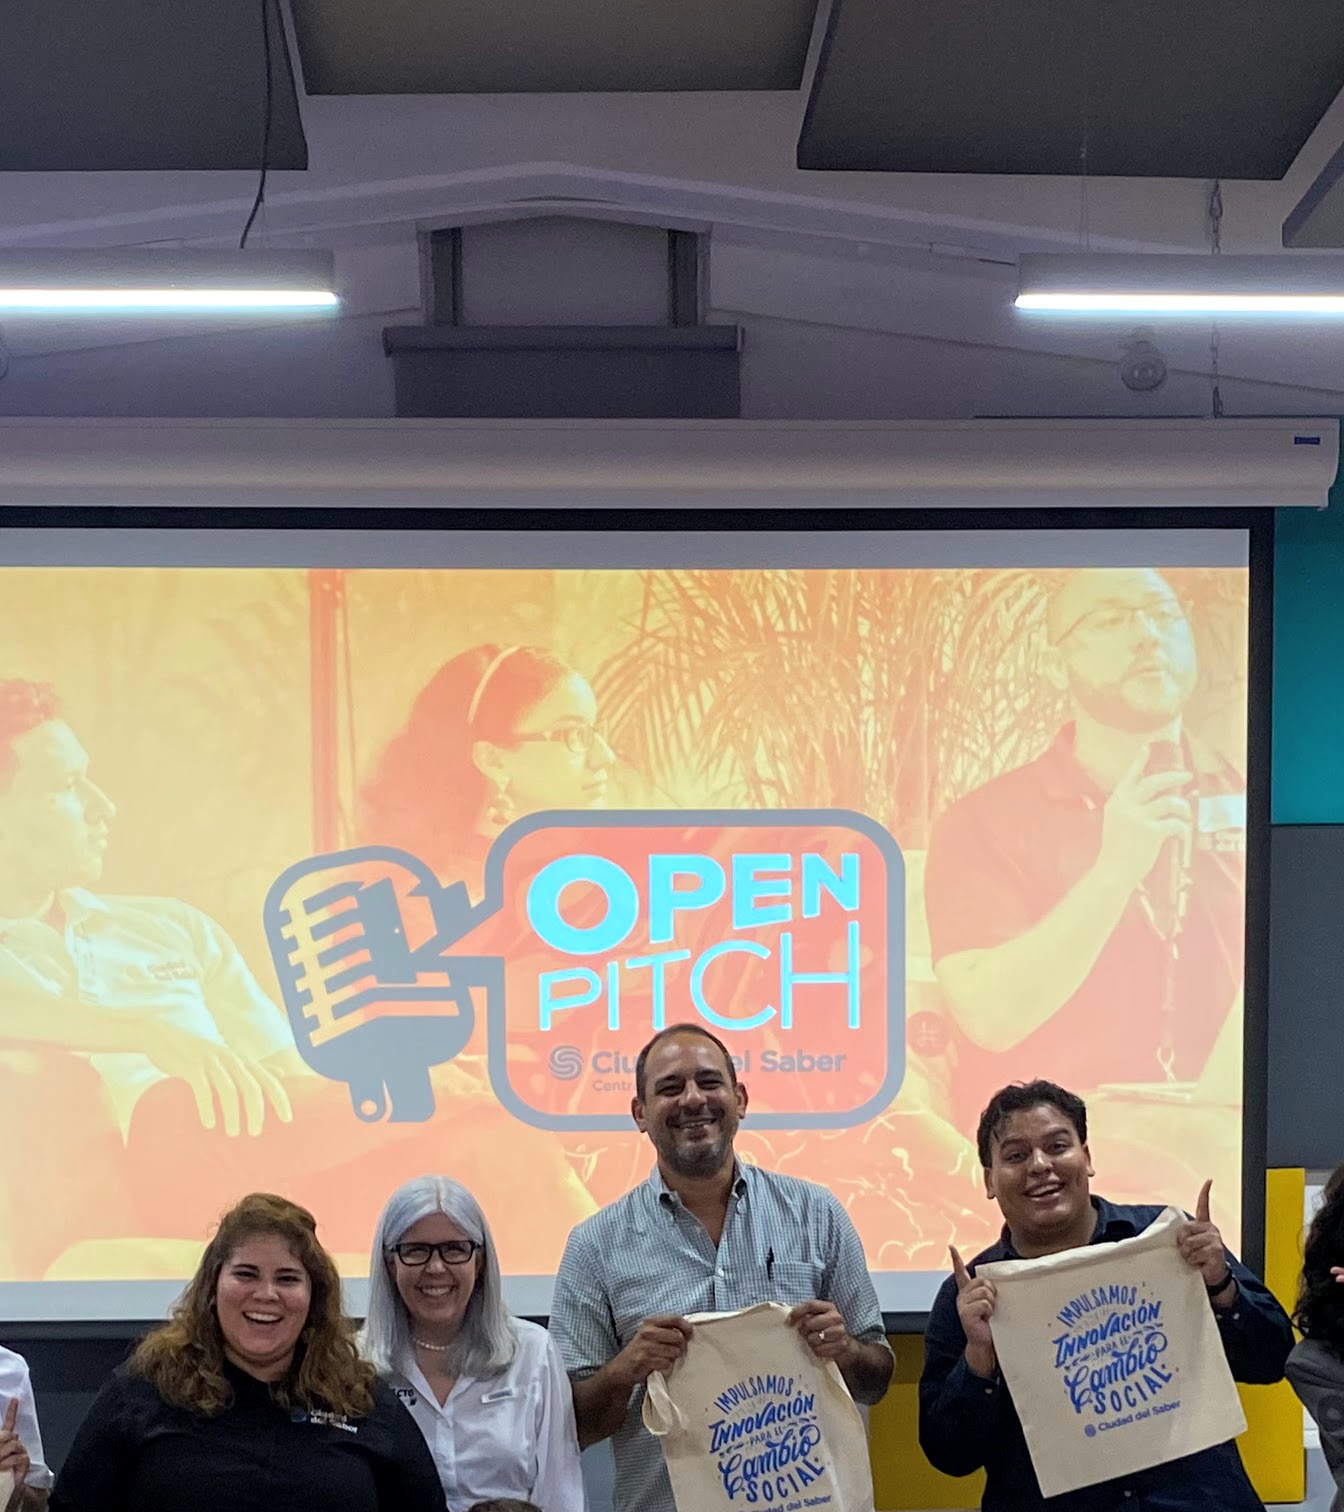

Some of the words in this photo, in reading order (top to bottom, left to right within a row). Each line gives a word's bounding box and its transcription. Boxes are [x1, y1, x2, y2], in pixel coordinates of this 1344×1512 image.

[526, 852, 860, 955] OPEN
[538, 920, 860, 1031] PITCH
[592, 1050, 637, 1074] Ciu
[730, 1049, 751, 1073] el
[760, 1049, 847, 1073] Saber
[592, 1080, 636, 1093] Centr
[1056, 1284, 1137, 1328] IMPULSAMOS
[1052, 1298, 1162, 1368] INNOVACIÓN
[713, 1374, 794, 1414] IMPULSAMOS
[1064, 1331, 1168, 1414] Cambio
[1093, 1365, 1173, 1415] SOCIAL
[708, 1390, 815, 1453] INNOVACIÓN
[1098, 1415, 1133, 1431] Ciudad
[1135, 1408, 1150, 1419] del
[1153, 1400, 1181, 1416] Saber
[718, 1423, 821, 1499] Cambio
[746, 1458, 825, 1503] SOCIAL
[786, 1501, 801, 1511] del
[804, 1495, 831, 1507] Saber
